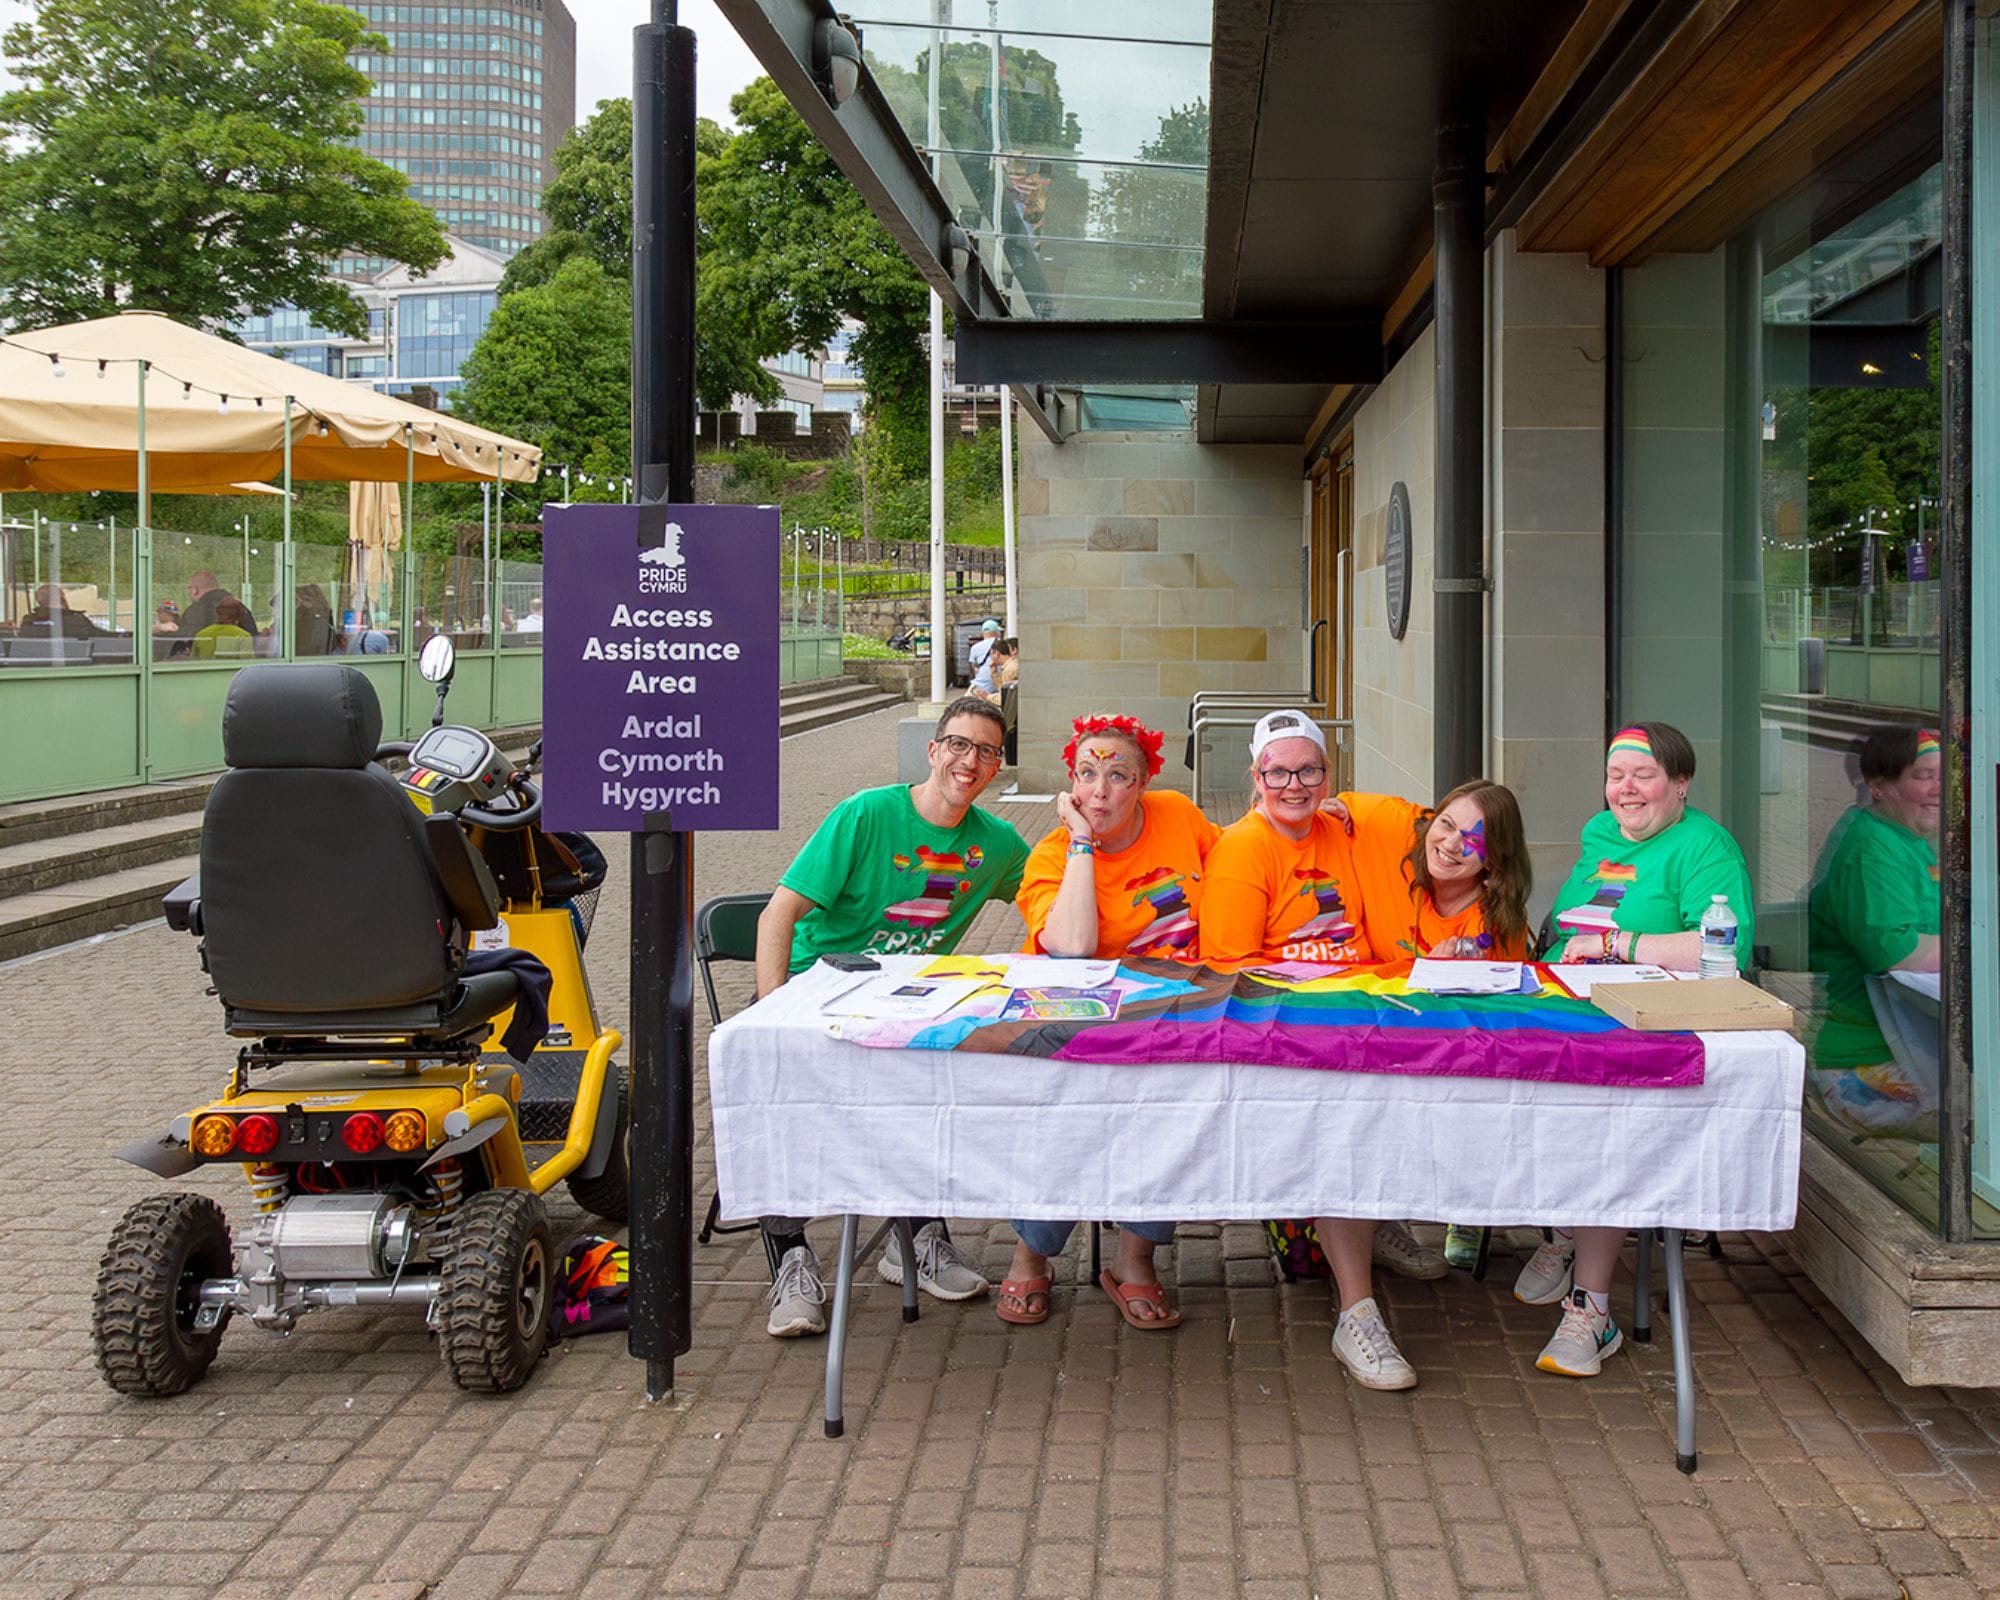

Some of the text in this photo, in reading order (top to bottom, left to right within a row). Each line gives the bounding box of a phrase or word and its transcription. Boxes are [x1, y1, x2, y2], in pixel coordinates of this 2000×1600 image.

[638, 581, 687, 594] CYMRU
[639, 568, 687, 582] PRIDE
[610, 603, 713, 628] Access
[581, 636, 741, 661] Assistance
[625, 670, 697, 694] Area
[621, 714, 701, 739] Ardal
[598, 748, 724, 777] Cymorth
[602, 781, 721, 811] Hygyrch
